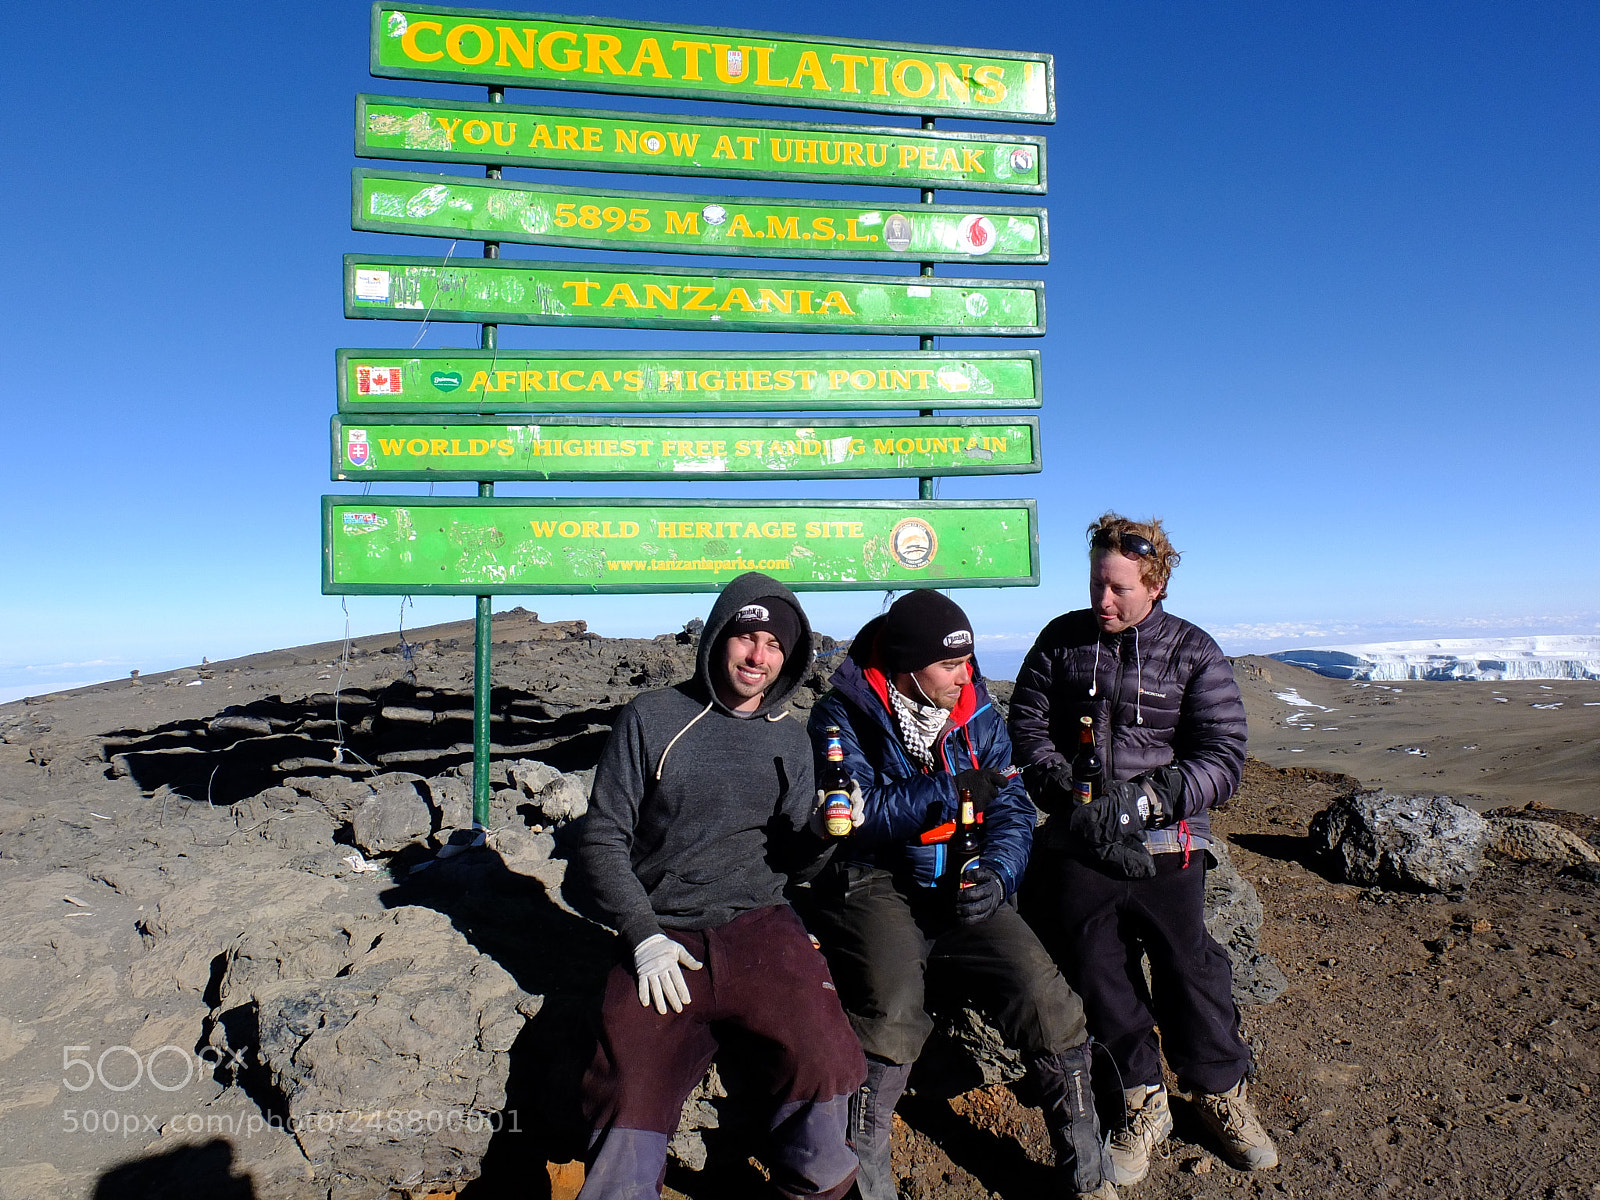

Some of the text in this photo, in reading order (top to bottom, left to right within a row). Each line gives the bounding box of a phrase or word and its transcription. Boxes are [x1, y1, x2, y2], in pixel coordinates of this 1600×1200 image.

[401, 21, 1007, 104] CONGRATULATIONS
[436, 117, 986, 173] YOU ARE NOW AT UHURU PEAK
[553, 203, 879, 242] 5895 M A.M.S.L.
[562, 281, 856, 315] TANZANIA
[467, 370, 645, 392] AFRICA'S
[657, 370, 817, 391] HIGHEST
[828, 369, 934, 390] POINT
[378, 437, 1007, 457] WORLD'S HIGHEST FREE STANDIG MOUNTAIN
[530, 521, 864, 539] WORLD HERITAGE SITE
[606, 556, 790, 574] www.tanzaniaparks.com
